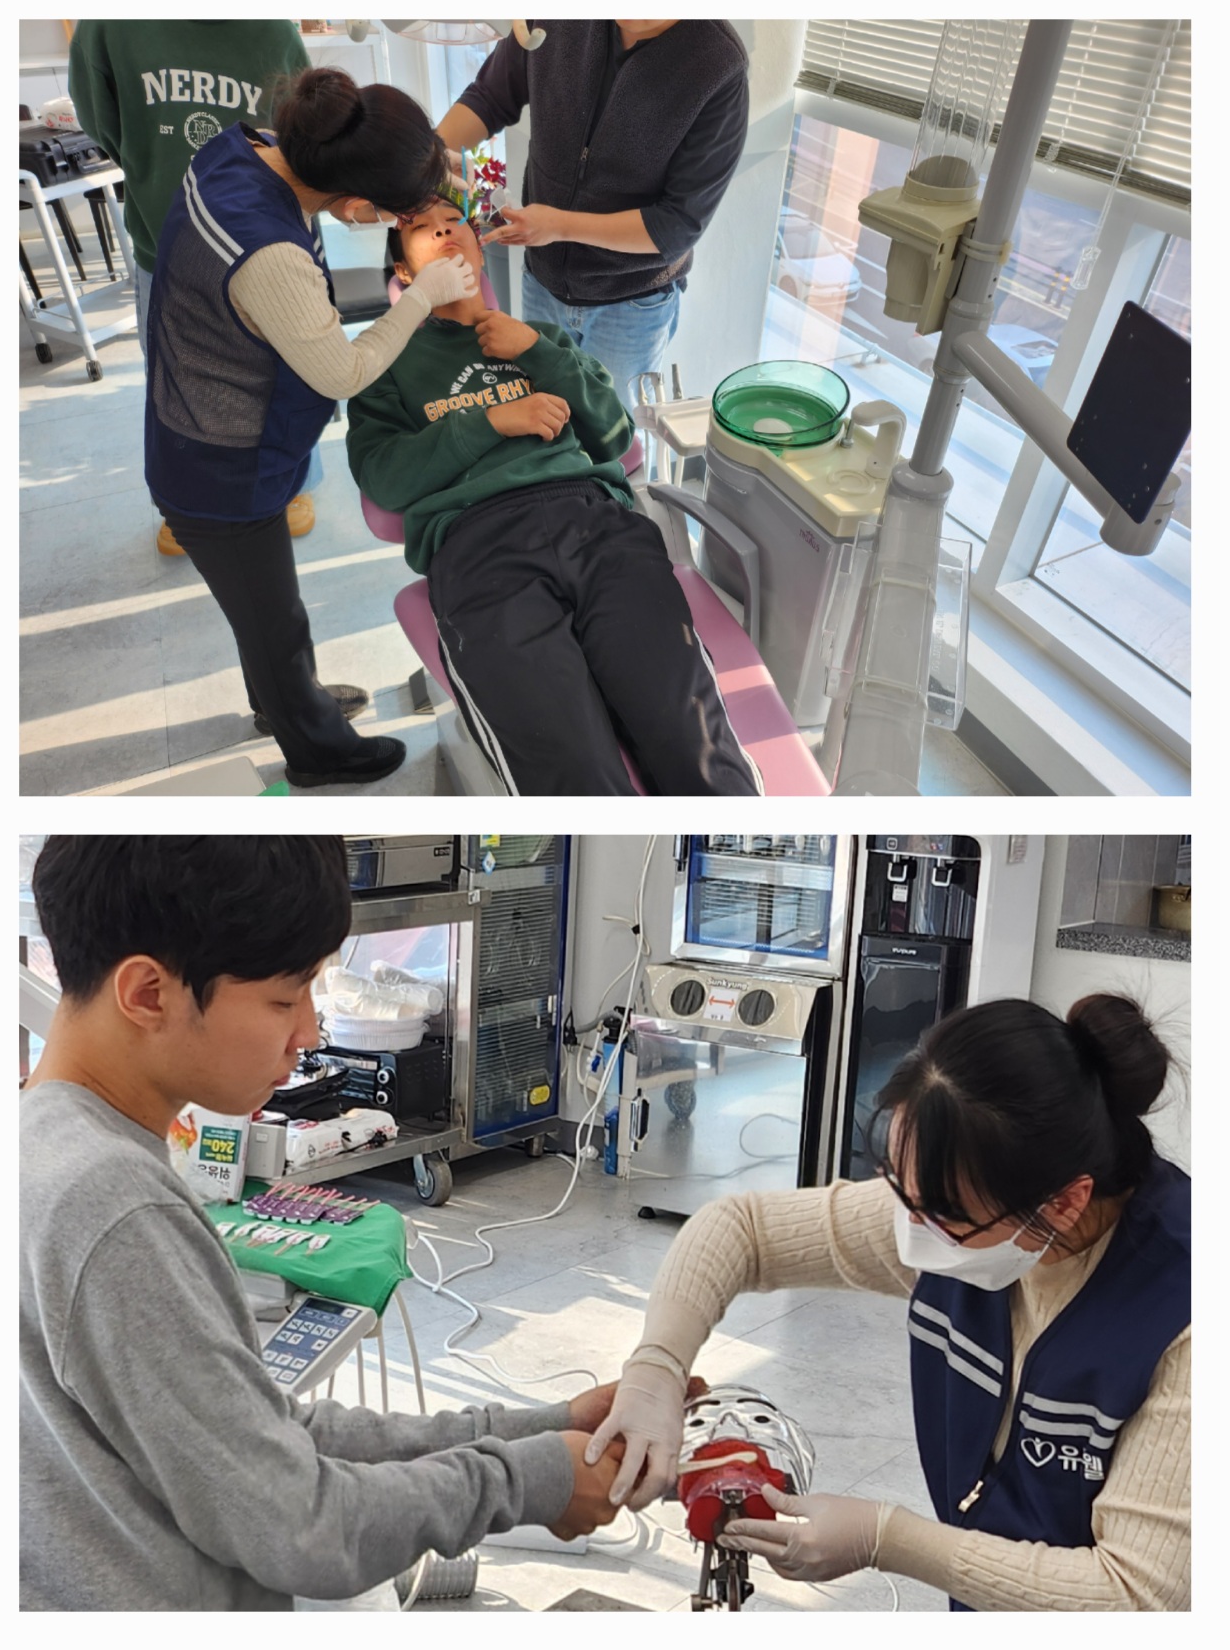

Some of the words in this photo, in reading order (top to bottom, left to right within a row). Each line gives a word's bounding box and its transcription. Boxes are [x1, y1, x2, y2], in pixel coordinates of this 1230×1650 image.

[141, 68, 263, 117] NERDY
[159, 124, 174, 135] EST
[424, 387, 498, 422] GROOVE
[210, 1139, 235, 1154] 240
